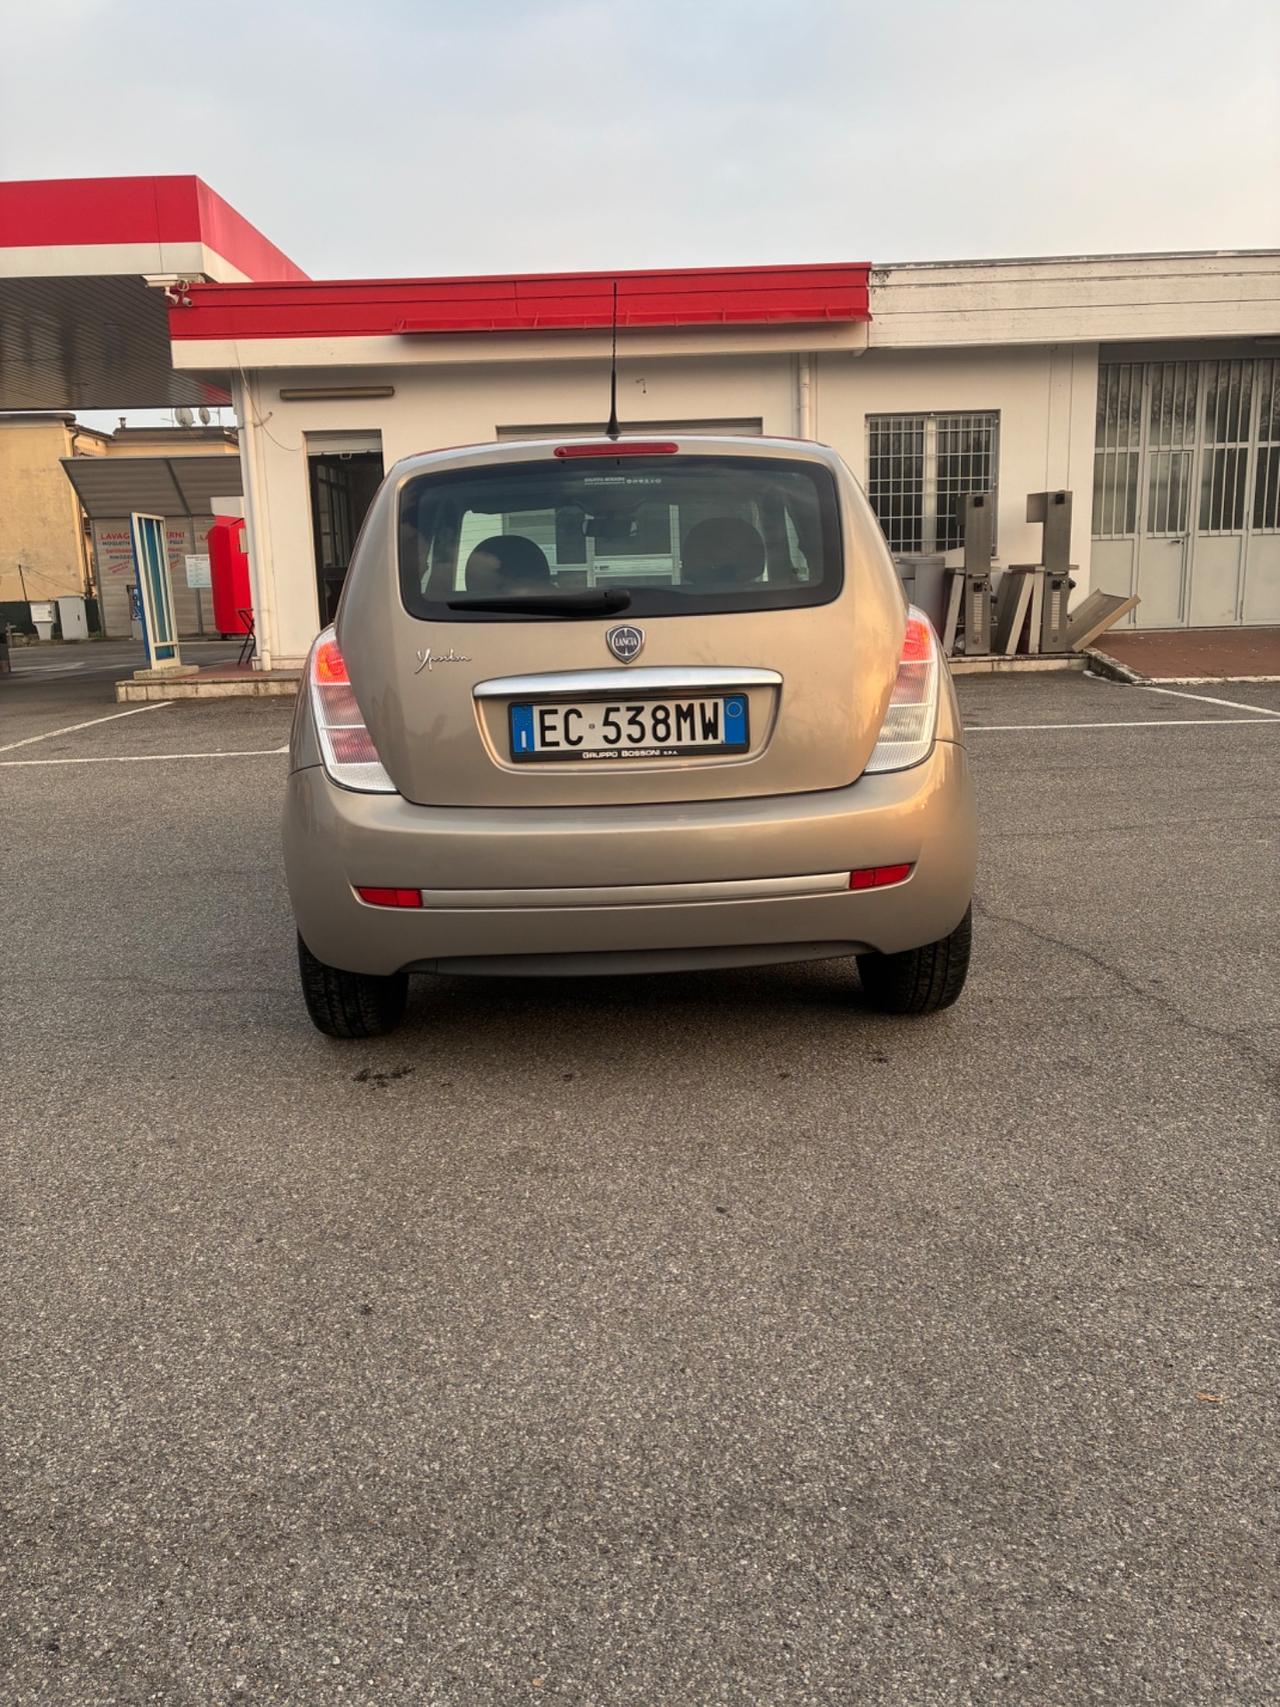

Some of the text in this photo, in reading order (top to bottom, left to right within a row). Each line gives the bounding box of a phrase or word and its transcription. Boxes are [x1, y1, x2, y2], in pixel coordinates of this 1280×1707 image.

[100, 532, 130, 540] LAVAG
[539, 702, 719, 747] EC 538MW
